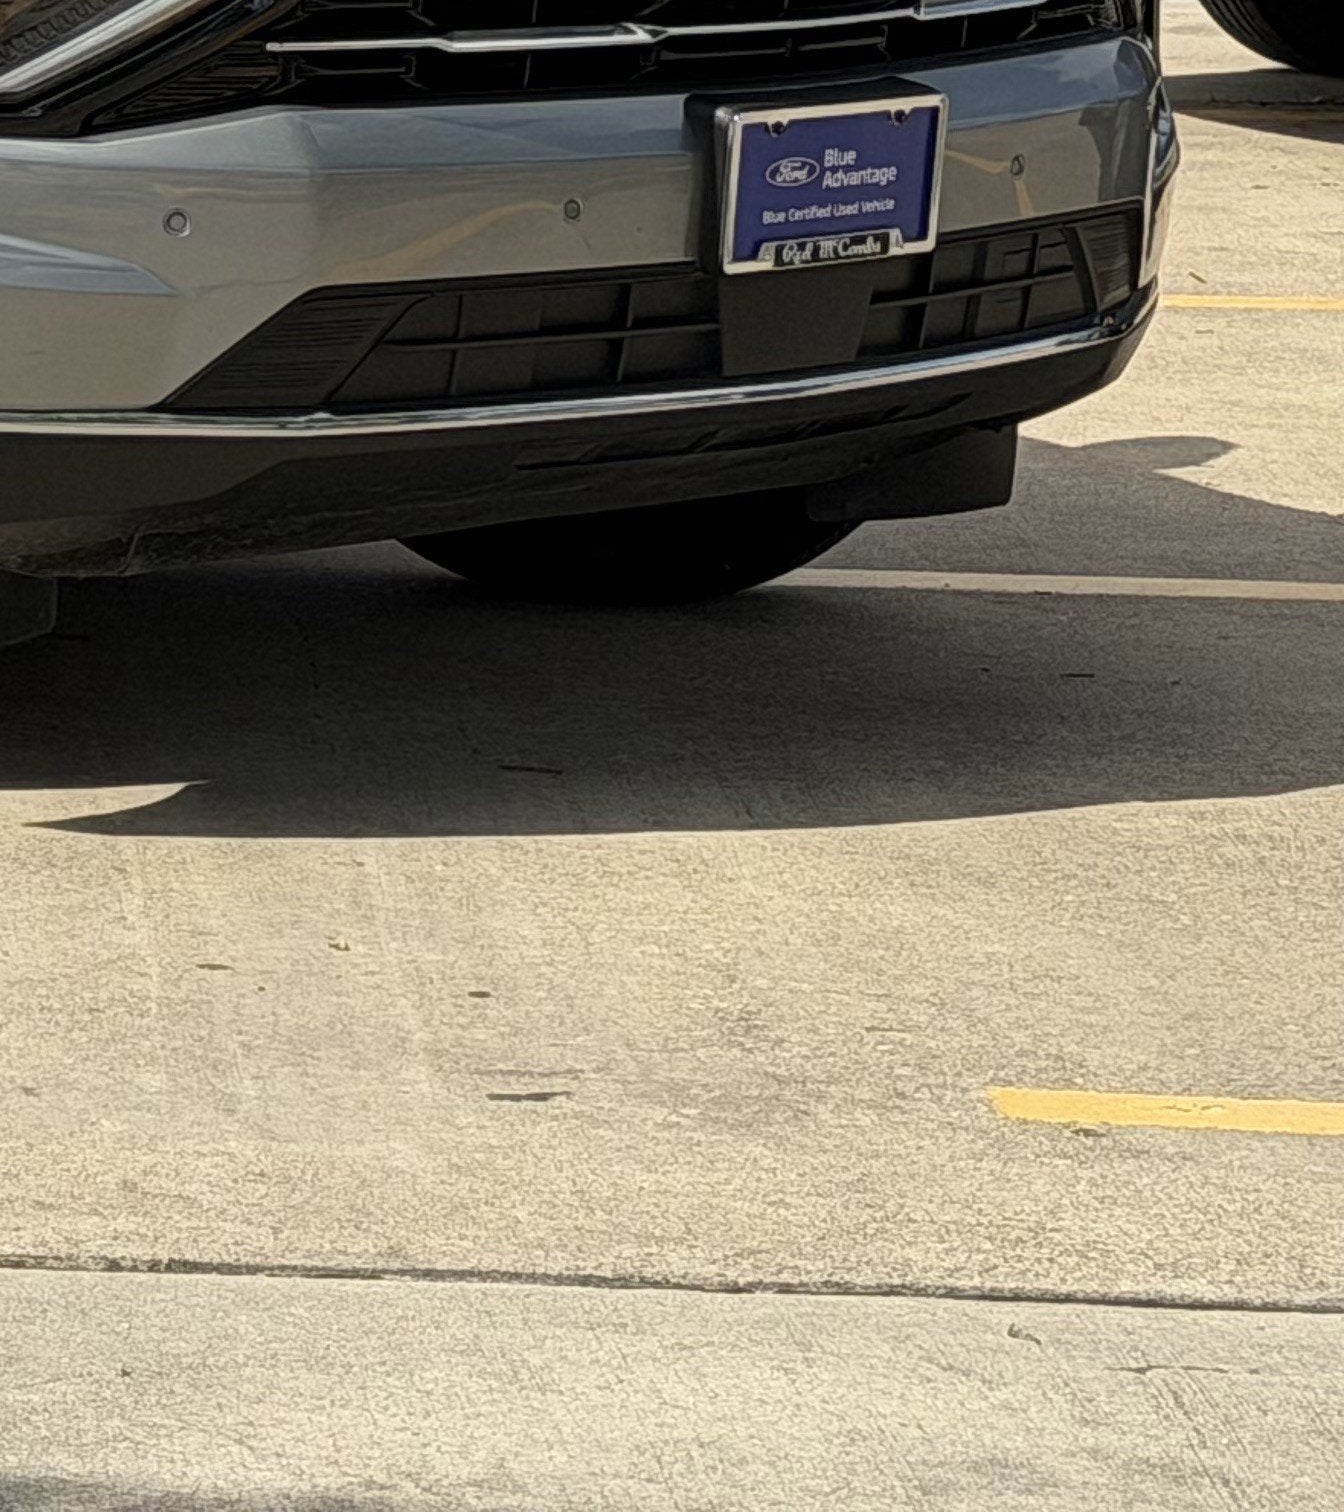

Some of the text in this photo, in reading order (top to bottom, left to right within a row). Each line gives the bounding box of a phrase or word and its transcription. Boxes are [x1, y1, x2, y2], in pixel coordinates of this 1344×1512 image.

[823, 148, 857, 168] Blue
[822, 166, 897, 188] Advantage
[762, 199, 895, 225] Blue Certified Used Vehicle
